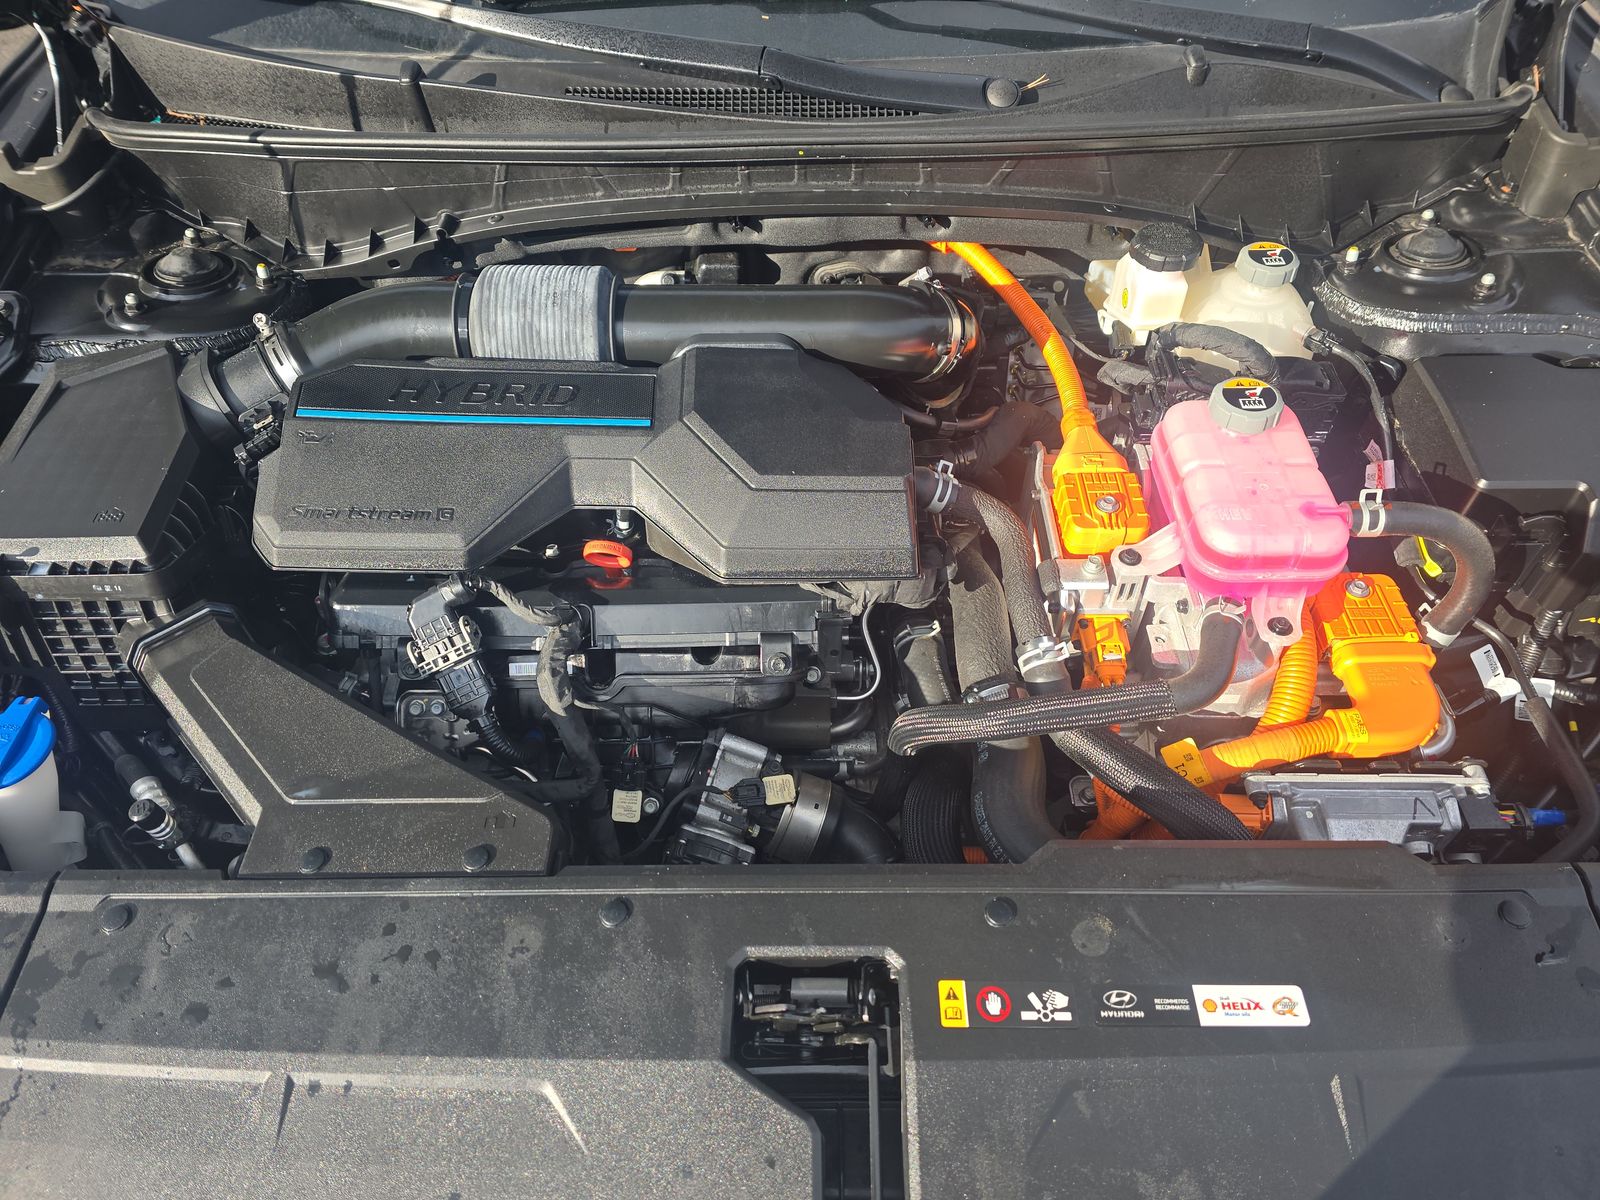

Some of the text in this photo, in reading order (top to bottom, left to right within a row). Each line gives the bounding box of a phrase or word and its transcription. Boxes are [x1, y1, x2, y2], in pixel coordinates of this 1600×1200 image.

[387, 377, 580, 407] HYBRID
[291, 503, 432, 521] Smartstream
[1221, 1002, 1265, 1011] HELIX
[1100, 1010, 1145, 1018] HYUNDAI
